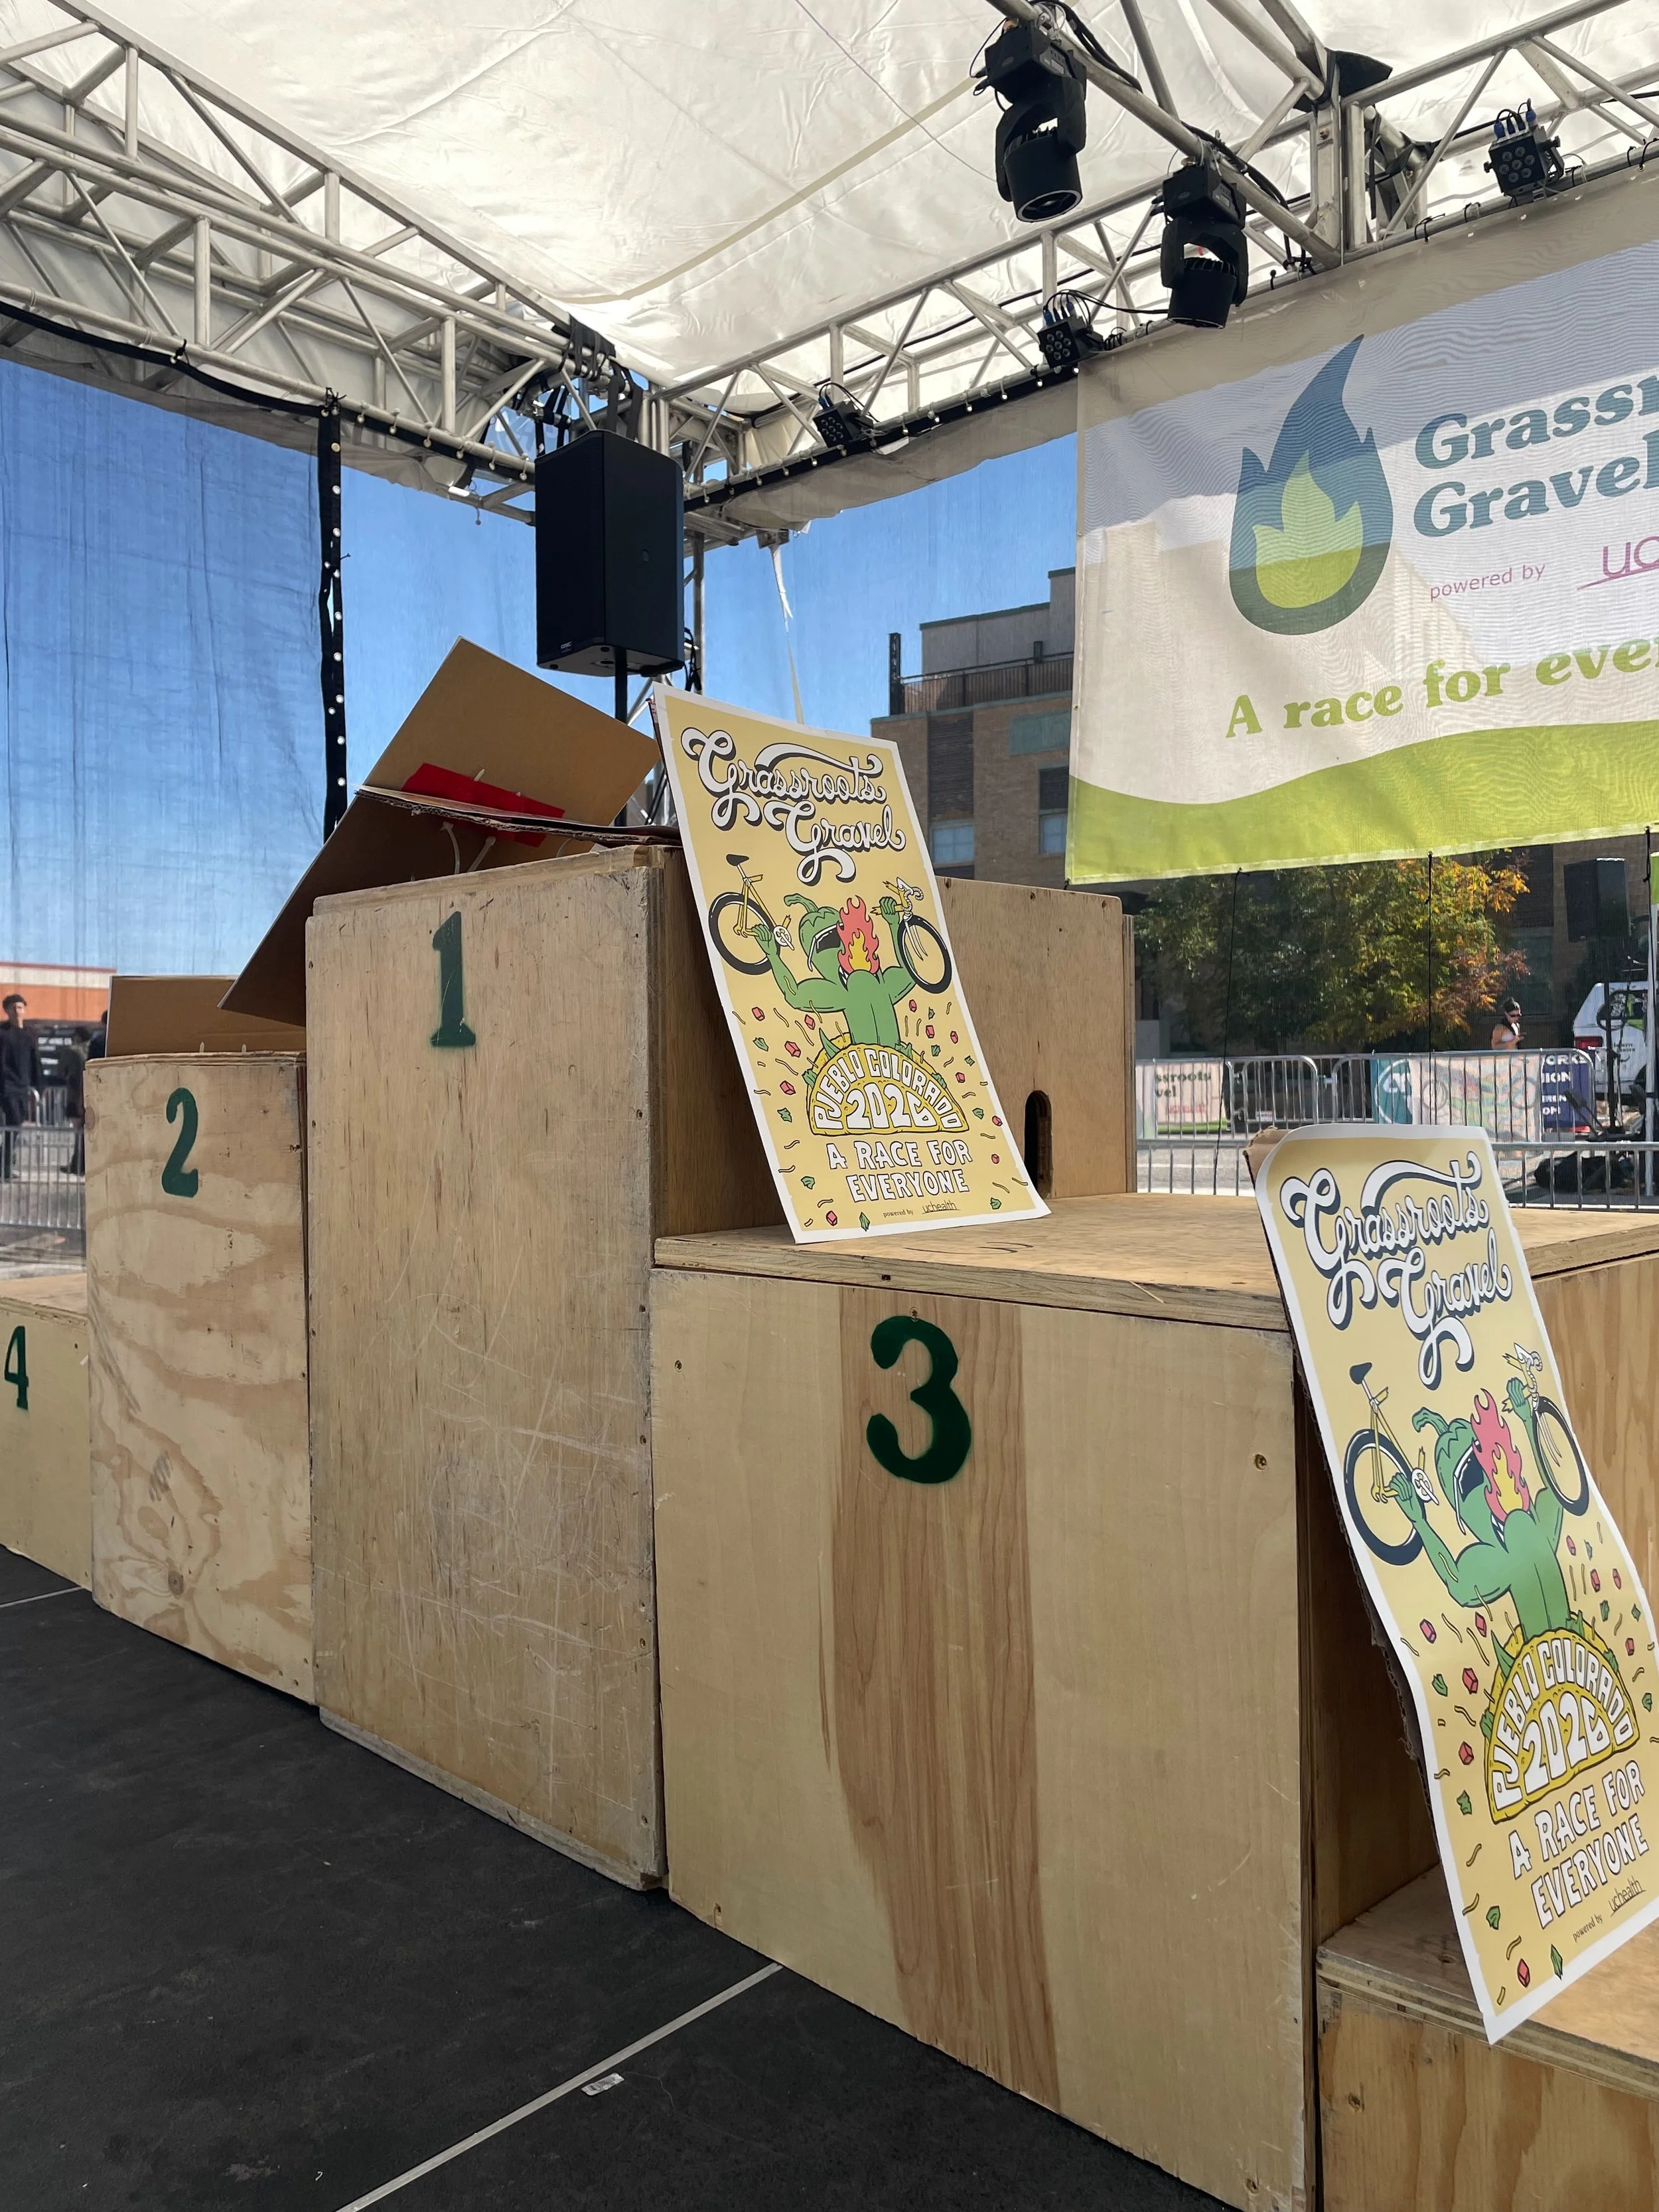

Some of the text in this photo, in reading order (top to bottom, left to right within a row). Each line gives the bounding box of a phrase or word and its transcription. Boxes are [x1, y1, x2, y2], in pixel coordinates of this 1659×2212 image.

[1429, 567, 1513, 603] powered
[1522, 564, 1546, 581] by
[1226, 694, 1263, 738] A
[1283, 686, 1404, 729] race
[1423, 659, 1511, 708] for
[681, 727, 887, 831] Grassroots
[763, 800, 906, 886] Gravel
[430, 911, 476, 1047] 1
[814, 1048, 963, 1129] PUEBLO COLORADO
[845, 1082, 938, 1129] 2026
[161, 1087, 199, 1198] 2
[826, 1139, 973, 1169] A RACE FOR
[846, 1169, 970, 1203] EVERYONE
[883, 1209, 906, 1218] powered
[922, 1200, 959, 1214] uchealth
[1279, 1151, 1488, 1330] Grassroots
[1376, 1227, 1512, 1390] Gravel
[4, 1326, 29, 1410] 4
[866, 1315, 971, 1484] 3
[1491, 1637, 1634, 1811] PUEBLO COLORADO
[1522, 1692, 1611, 1796] 2026
[1508, 1759, 1646, 1880] A RACE FOR
[1531, 1813, 1649, 1930] EVERYONE
[1572, 1876, 1644, 1943] powered by uchealth
